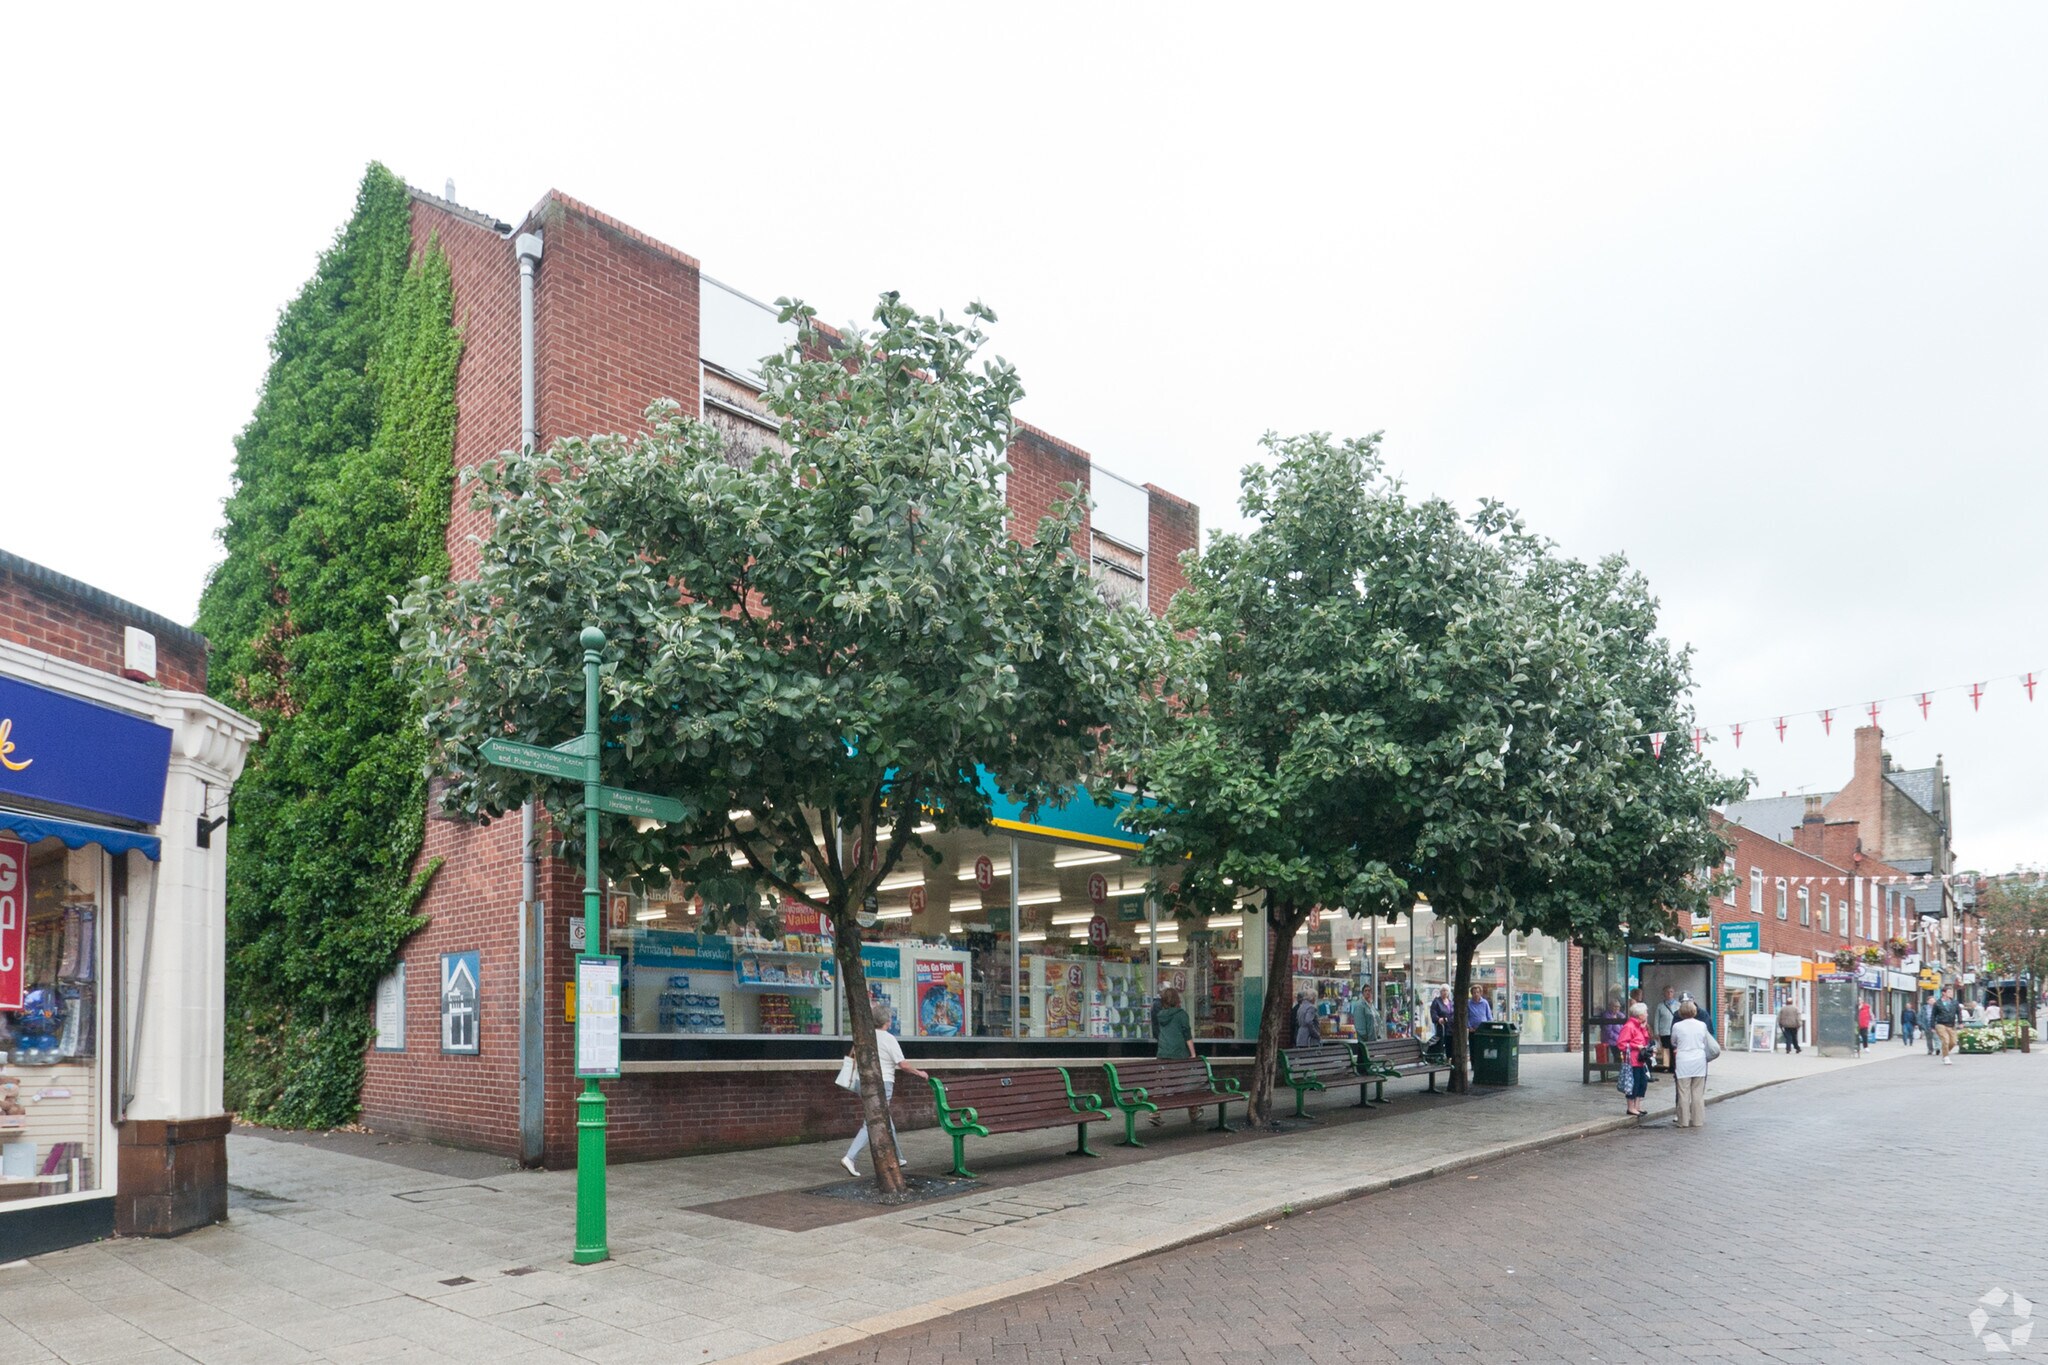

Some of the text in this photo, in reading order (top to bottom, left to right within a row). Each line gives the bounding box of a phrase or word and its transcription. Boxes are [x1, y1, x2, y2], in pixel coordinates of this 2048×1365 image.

[492, 742, 584, 767] Derwent Valley Visitor Centre
[498, 755, 560, 772] and River Gardens
[612, 792, 633, 802] Market
[608, 800, 654, 814] Heritage Centre
[978, 863, 991, 885] £1
[1091, 880, 1105, 898] £1
[911, 891, 924, 910] £1
[787, 912, 819, 927] Value!
[1091, 922, 1107, 942] £1
[639, 943, 672, 957] Amazing
[697, 946, 731, 960] Everyday!
[871, 958, 898, 970] Everyday!
[916, 963, 955, 972] Kids Go Free!
[1302, 953, 1312, 971] £1
[1070, 967, 1081, 985] £1
